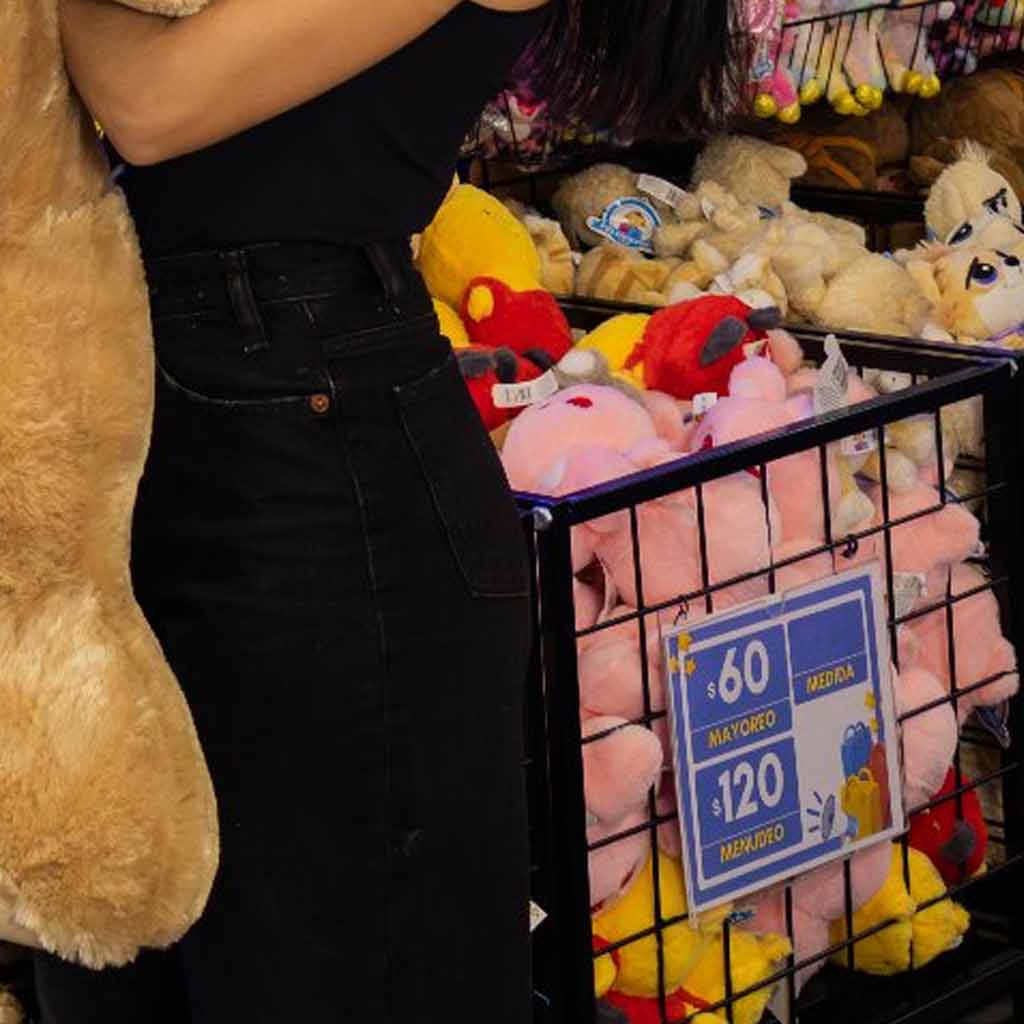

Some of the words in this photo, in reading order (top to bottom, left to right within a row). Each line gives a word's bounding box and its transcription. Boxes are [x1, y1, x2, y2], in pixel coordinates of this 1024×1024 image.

[707, 640, 770, 705] $60
[806, 664, 855, 694] MEDIDA
[708, 710, 777, 748] MAYOREO
[712, 752, 785, 823] $120
[720, 823, 785, 864] MENUDEO
